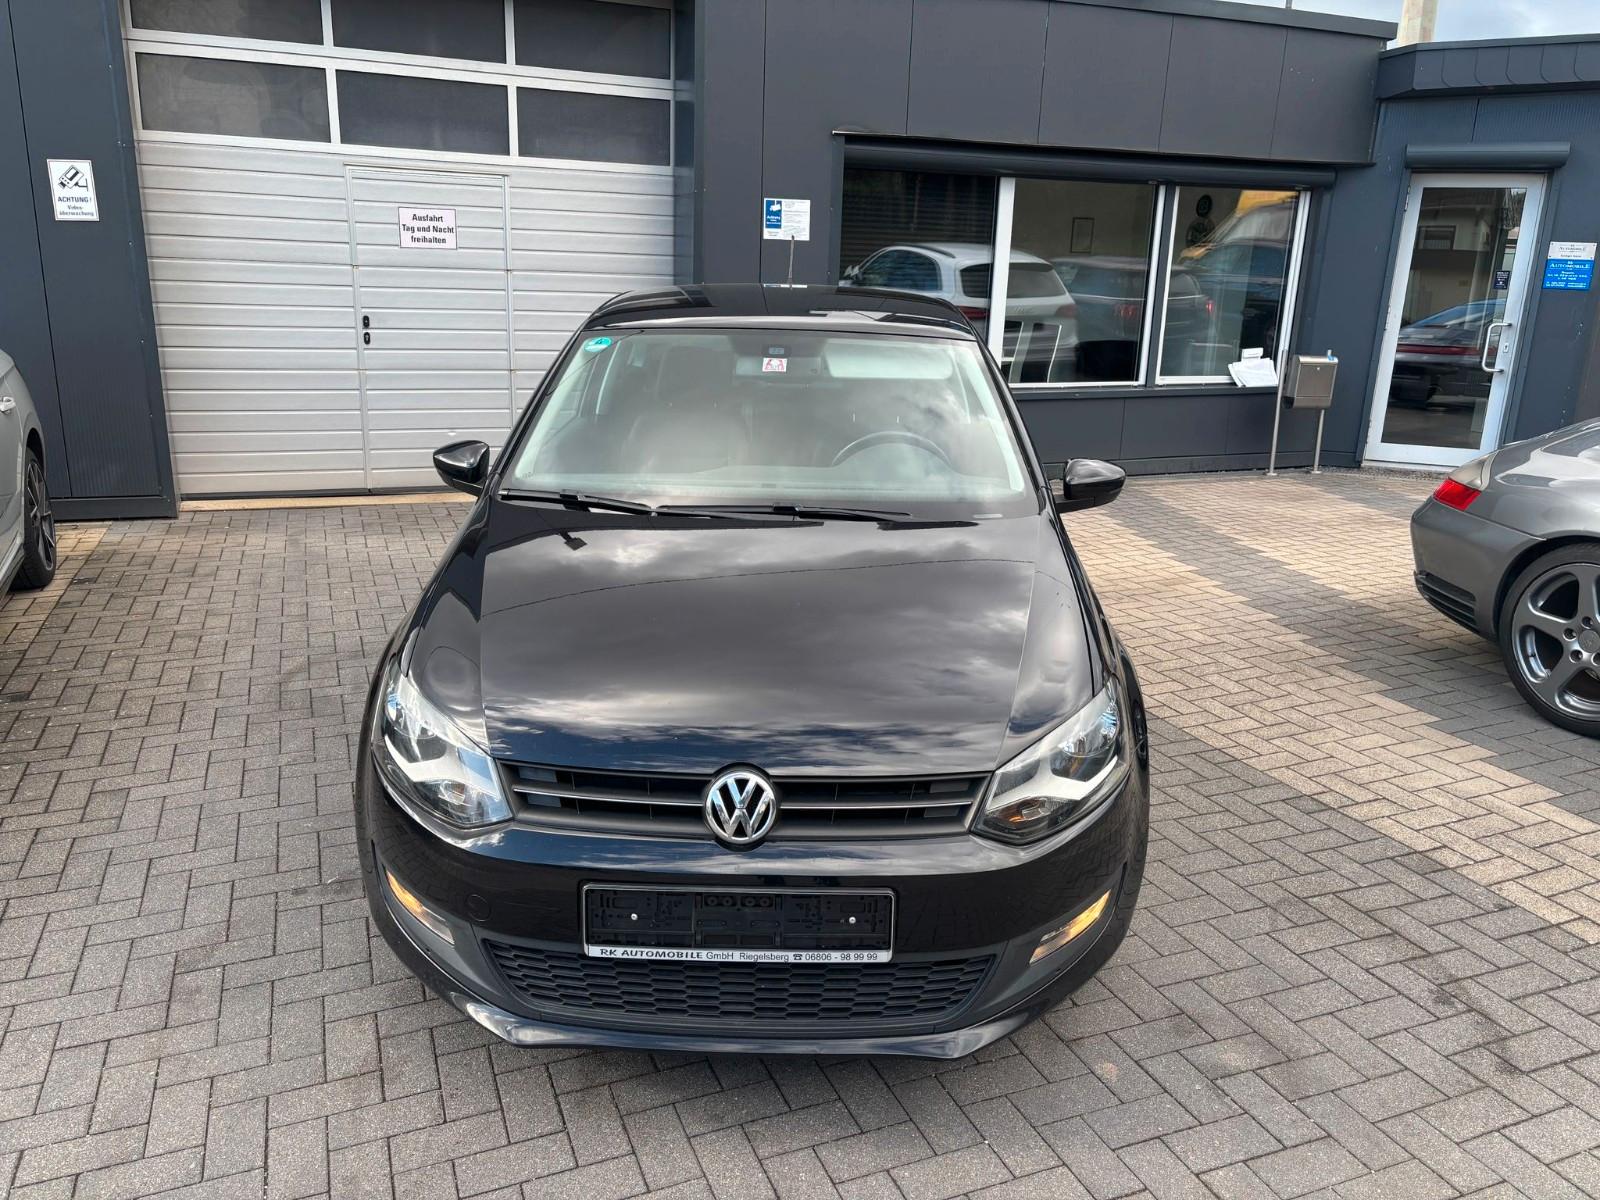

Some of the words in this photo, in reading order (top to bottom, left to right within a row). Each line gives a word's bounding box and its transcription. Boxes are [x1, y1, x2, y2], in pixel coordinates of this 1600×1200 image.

[412, 213, 444, 222] Ausfahrt
[402, 223, 415, 234] Tag
[416, 225, 431, 233] und
[432, 225, 455, 234] Nacht
[411, 235, 447, 244] freihalten
[599, 948, 617, 957] RK
[621, 949, 703, 959] AUTOMOBILE
[706, 951, 734, 960] GmbH
[739, 952, 790, 962] Riegelsberg
[804, 953, 832, 961] 06806
[840, 953, 851, 961] 98
[853, 953, 865, 961] 99
[866, 953, 878, 961] 99
